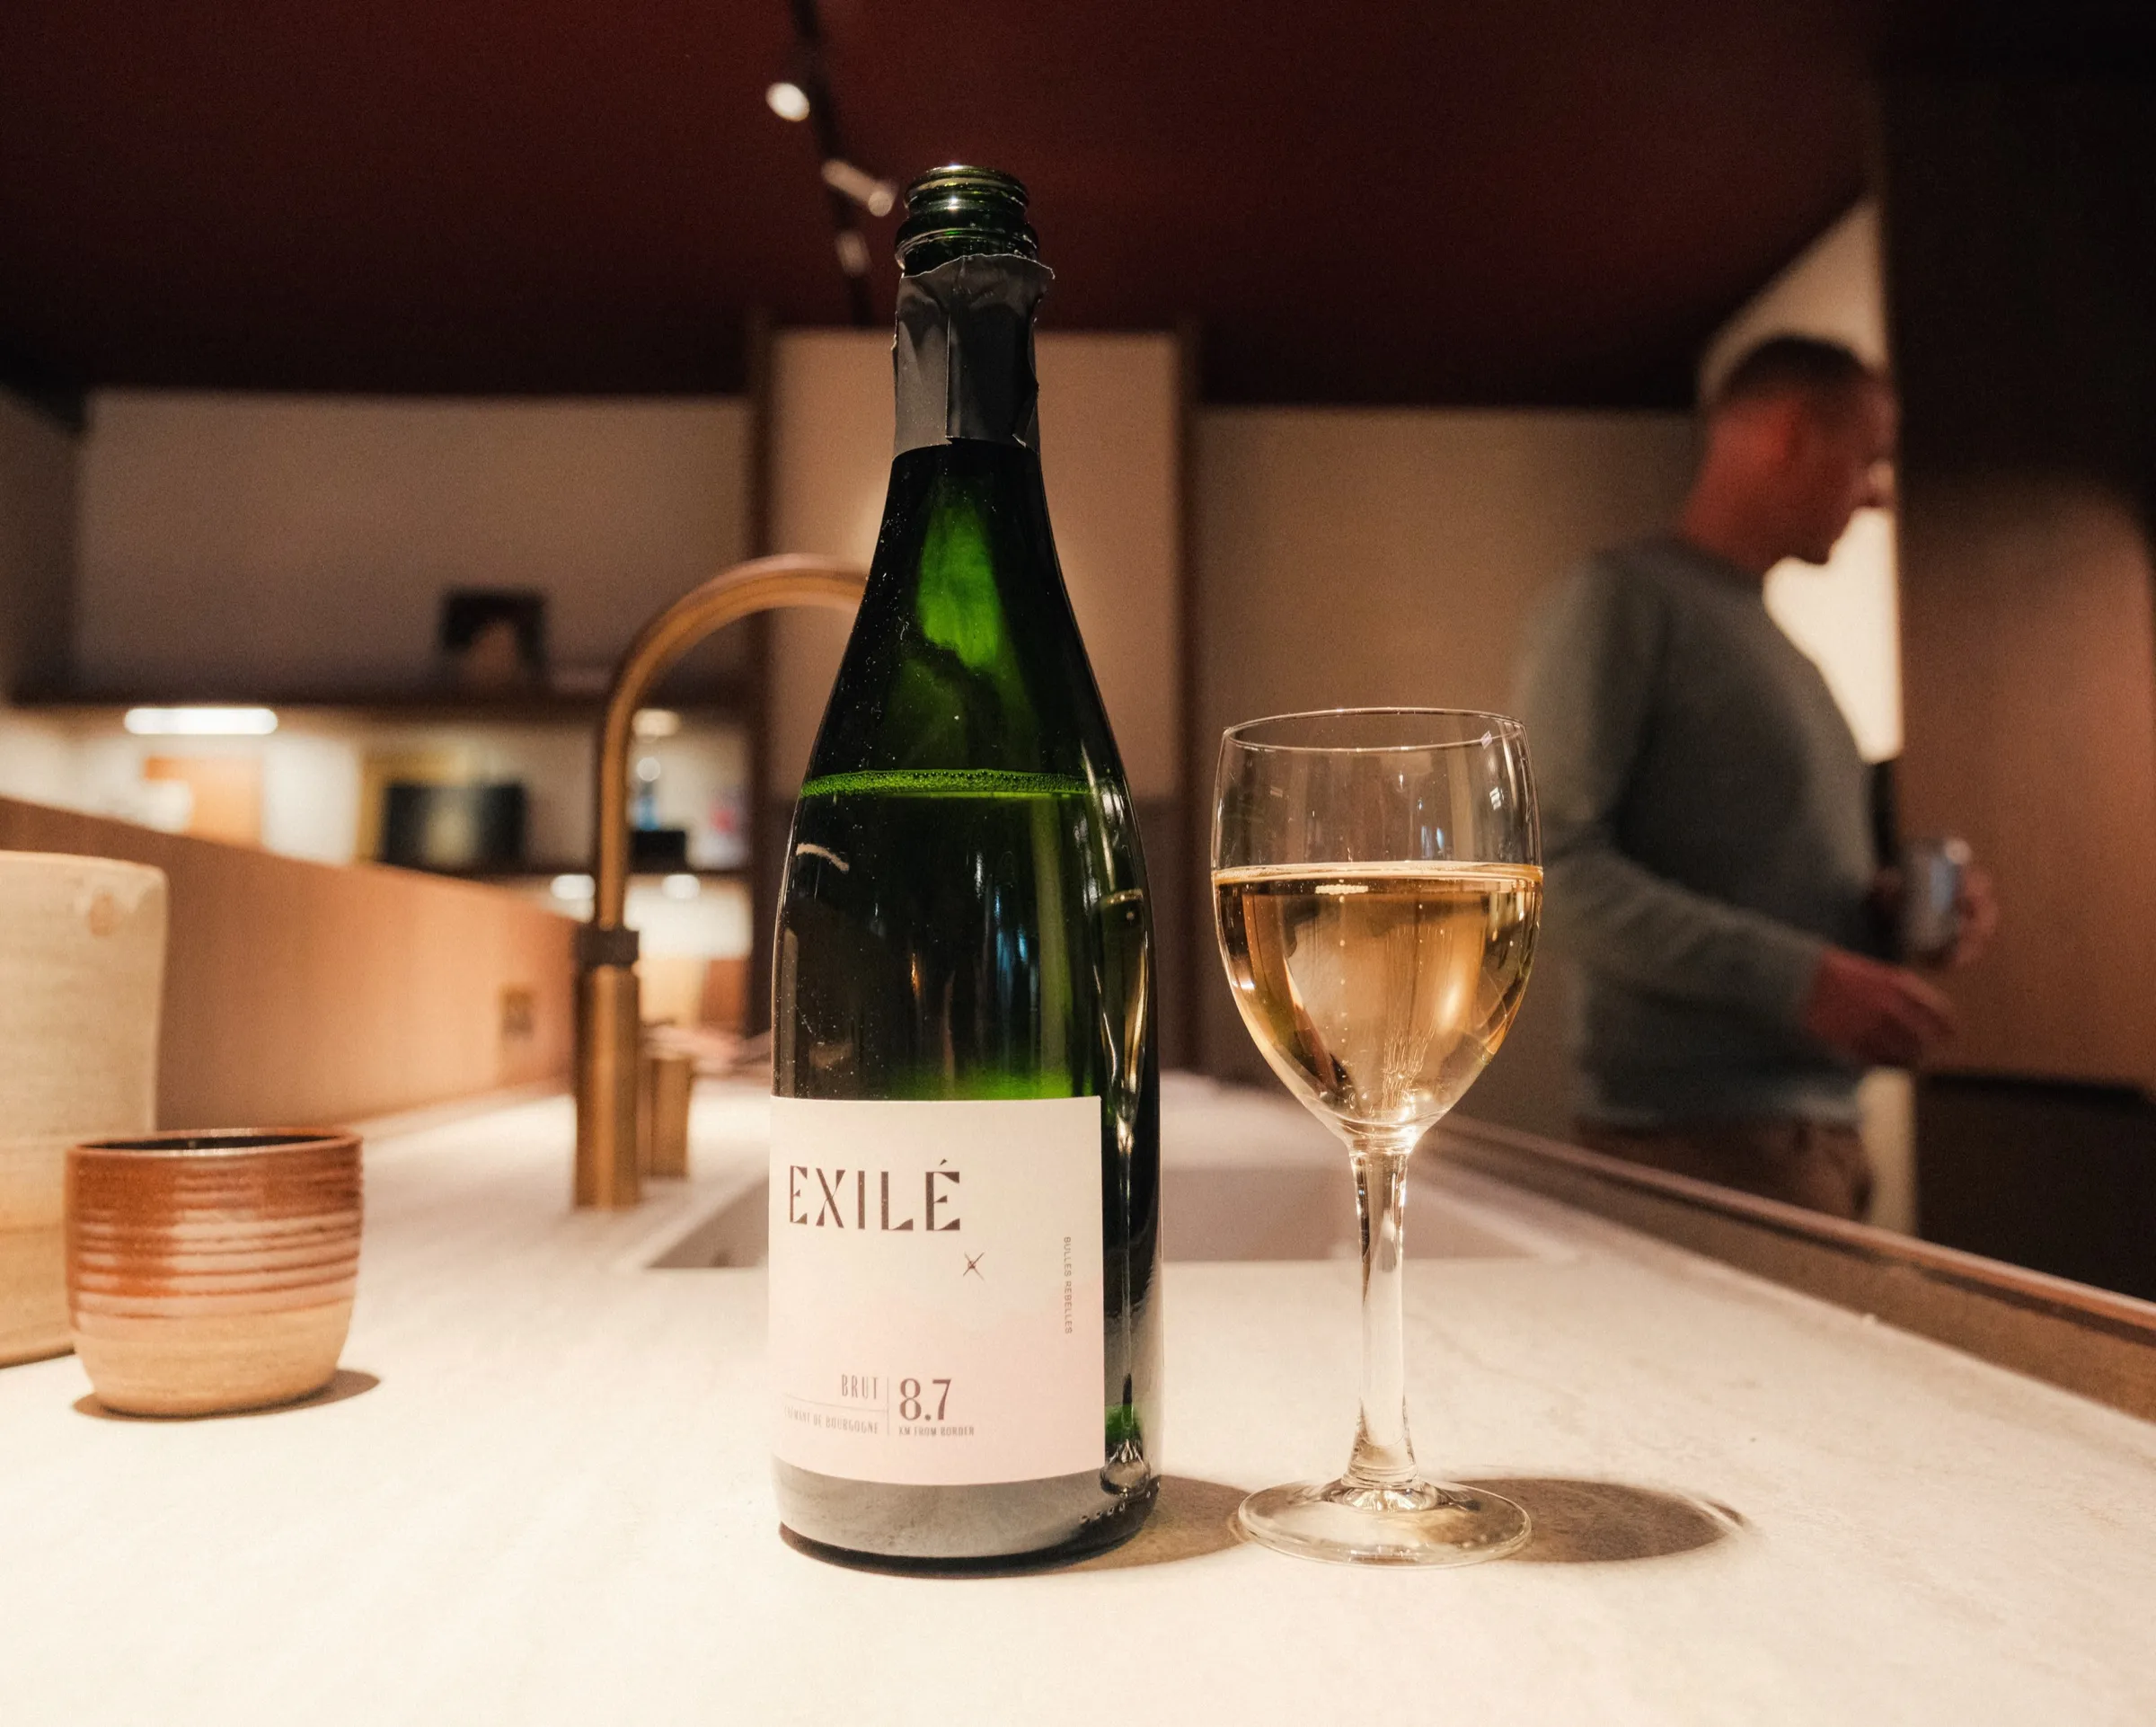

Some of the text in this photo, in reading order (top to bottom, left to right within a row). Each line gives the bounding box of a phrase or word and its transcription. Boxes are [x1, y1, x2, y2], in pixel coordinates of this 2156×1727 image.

[790, 1158, 960, 1231] EXILÉ
[1064, 1236, 1073, 1334] BULLES REBELLES
[842, 1374, 879, 1400] BRUT
[900, 1377, 952, 1421] 8.7
[813, 1413, 823, 1428] DE
[826, 1416, 879, 1435] BOURGOGNE
[899, 1425, 975, 1437] KM FROM BORDER
